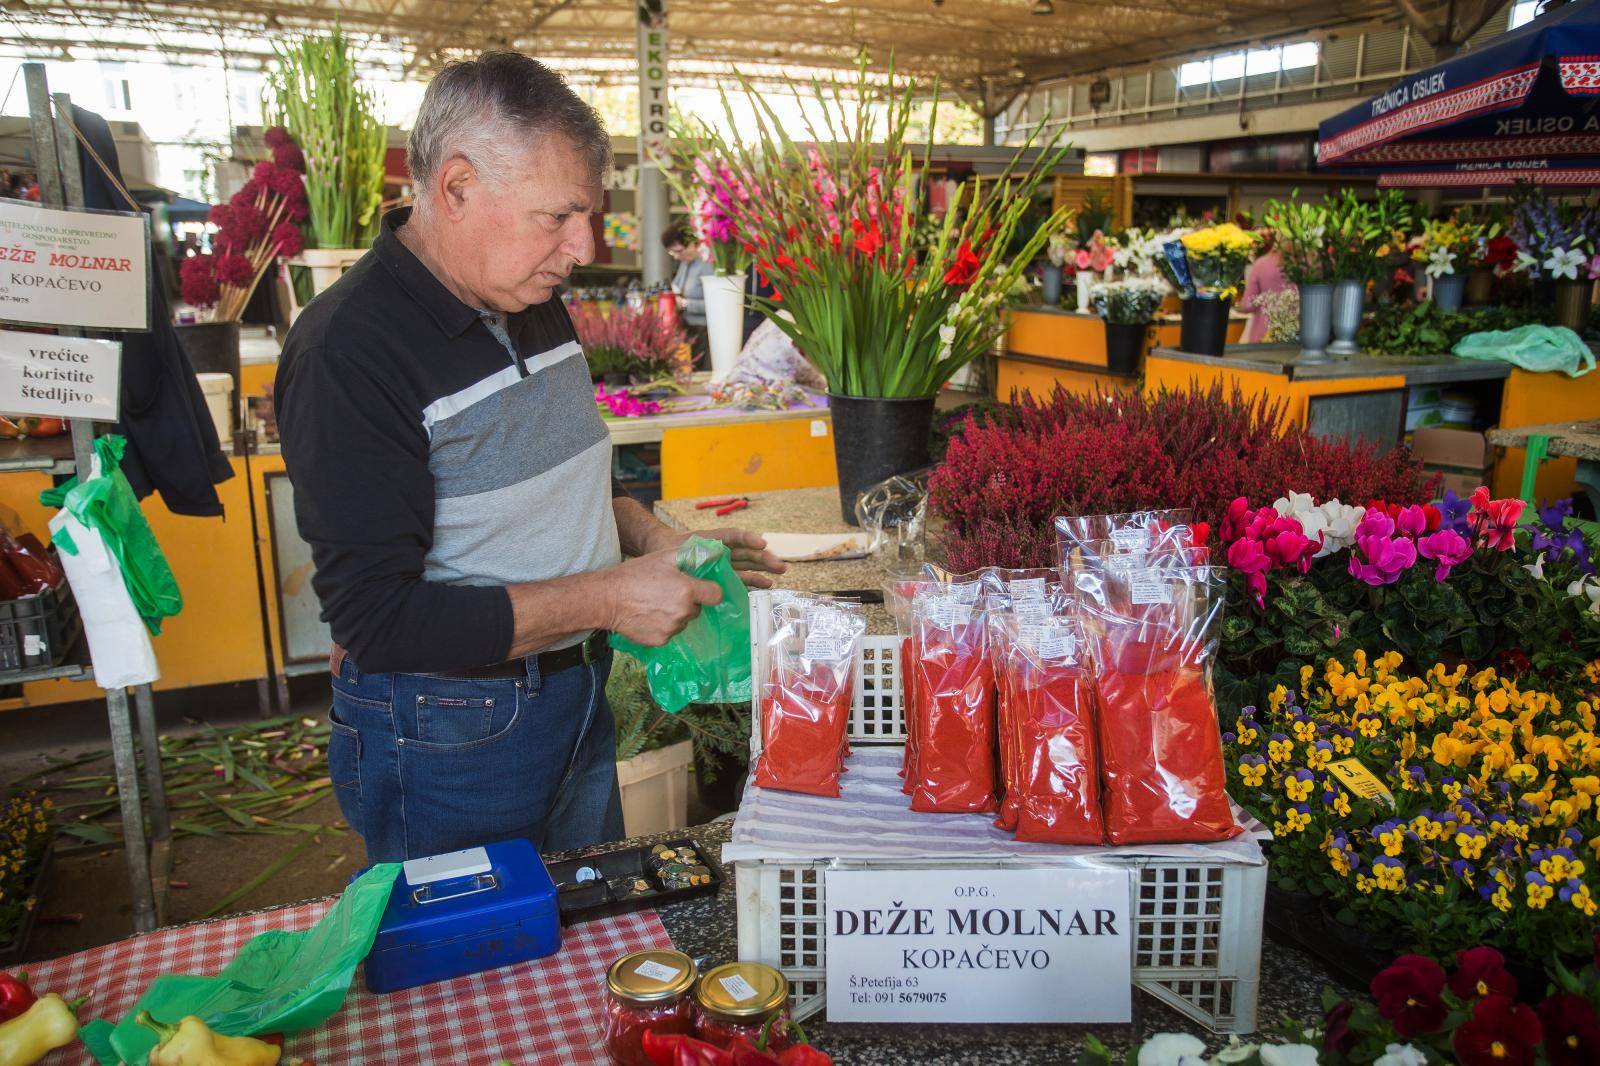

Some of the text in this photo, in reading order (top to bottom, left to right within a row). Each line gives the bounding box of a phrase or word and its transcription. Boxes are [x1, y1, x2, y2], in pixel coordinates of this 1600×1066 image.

[647, 32, 665, 134] EKO TRG
[1371, 72, 1446, 117] TRŽNICA OSIJEK
[22, 232, 90, 246] GOSPODARSTVO
[49, 253, 132, 272] MOLNAR
[11, 272, 102, 293] KOPAČEVO
[29, 348, 89, 363] vrećice
[23, 365, 95, 384] koristite
[22, 384, 94, 405] štedljivo
[833, 900, 1120, 937] DEŽE MOLNAR
[902, 943, 1050, 970] KOPAČEVO
[850, 974, 919, 989] Š.Petefija 63
[850, 991, 947, 1004] Tel: 091 5679075
